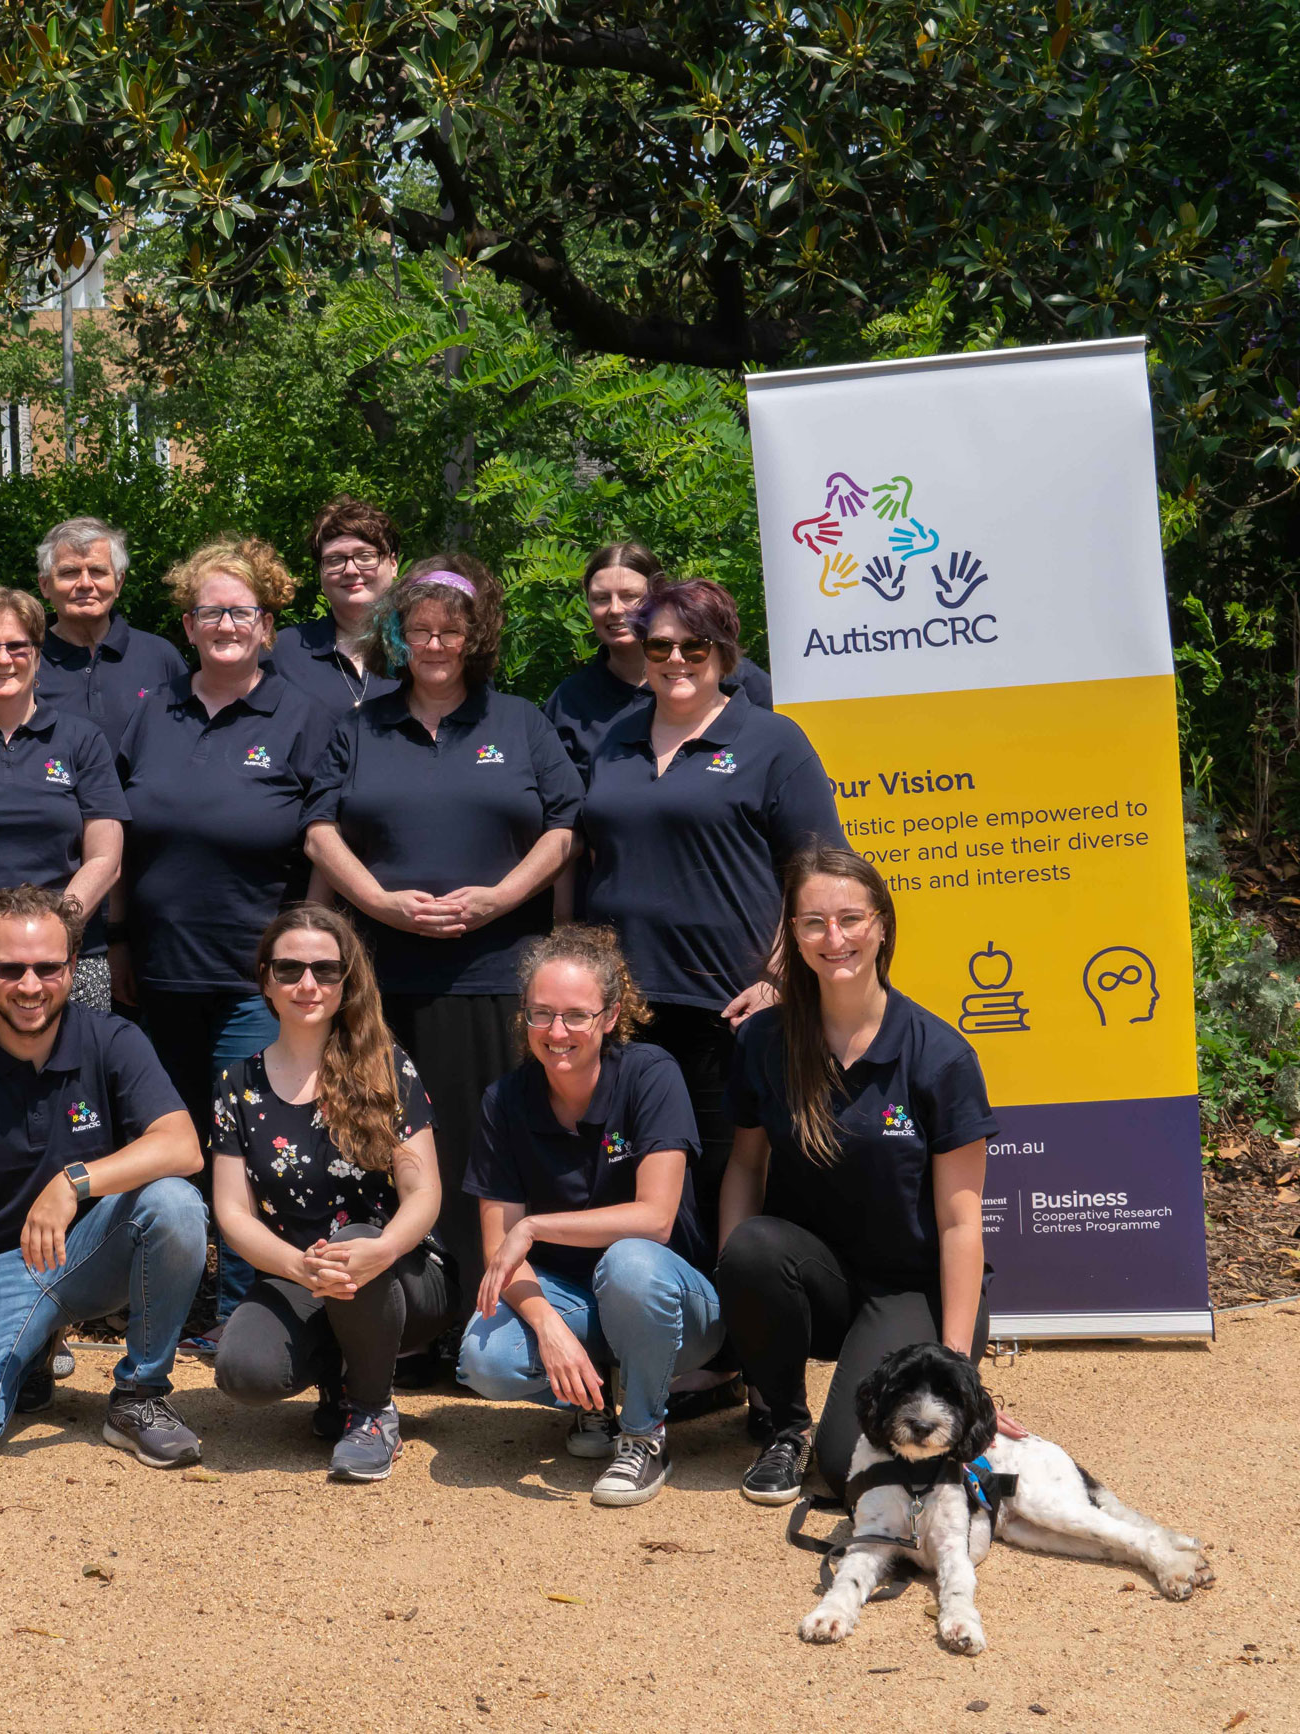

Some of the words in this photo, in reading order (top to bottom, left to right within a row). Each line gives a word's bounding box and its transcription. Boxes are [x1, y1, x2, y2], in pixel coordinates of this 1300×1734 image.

[803, 614, 998, 657] AutismCRC
[878, 769, 975, 796] Vision
[842, 817, 896, 837] tistic
[903, 811, 978, 836] people
[986, 800, 1119, 828] empowered
[1125, 801, 1148, 817] to
[857, 848, 910, 864] over
[918, 841, 958, 861] and
[966, 842, 1004, 857] use
[1011, 835, 1060, 854] their
[1068, 832, 1149, 850] diverse
[885, 874, 922, 892] ths
[929, 869, 969, 888] and
[977, 865, 1071, 886] interests
[985, 1141, 1045, 1156] om.au
[1031, 1190, 1128, 1209] Business
[982, 1214, 1005, 1223] stry,
[1032, 1209, 1110, 1222] Cooperative
[1114, 1206, 1172, 1219] Research
[1033, 1222, 1082, 1234] Centres
[1085, 1220, 1161, 1232] Programme
